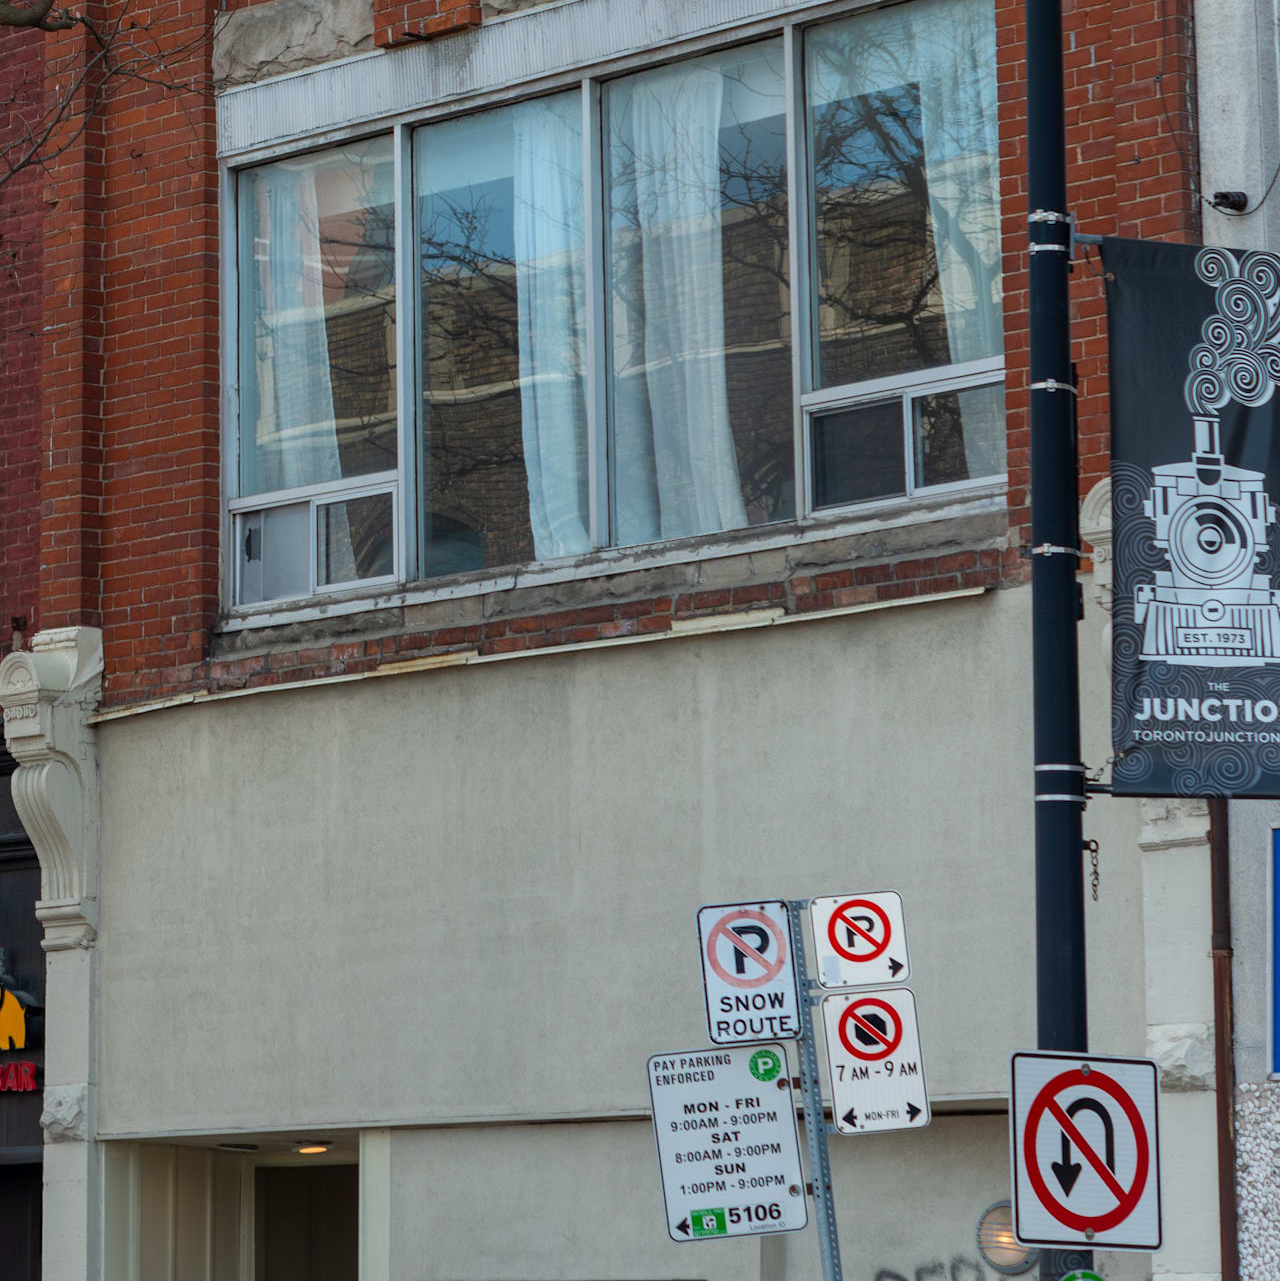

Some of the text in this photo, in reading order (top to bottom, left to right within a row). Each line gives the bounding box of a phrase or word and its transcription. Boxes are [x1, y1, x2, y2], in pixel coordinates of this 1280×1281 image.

[1184, 633, 1245, 644] EST. 1973
[1207, 682, 1230, 692] THE
[1134, 697, 1280, 723] JUNCTIO
[720, 992, 785, 1013] SNOW
[716, 1015, 793, 1037] ROUTE
[653, 1054, 732, 1072] PAY PARKING
[836, 1064, 846, 1082] 7
[851, 1066, 870, 1081] AM
[884, 1061, 895, 1077] 9
[899, 1062, 918, 1076] AM
[656, 1070, 715, 1086] ENFORCED
[683, 1101, 719, 1115] MON
[735, 1097, 761, 1110] FRI
[671, 1117, 719, 1132] 9:00AM
[730, 1112, 778, 1126] 9:00PM
[864, 1110, 901, 1122] MON-FRI
[711, 1131, 741, 1143] SAT
[675, 1149, 723, 1164] 8:00AM
[734, 1143, 782, 1158] 9:00PM
[714, 1163, 747, 1175] SUN
[680, 1181, 727, 1195] 1:00PM
[739, 1175, 786, 1190] 9:00PM
[728, 1203, 782, 1224] 5106
